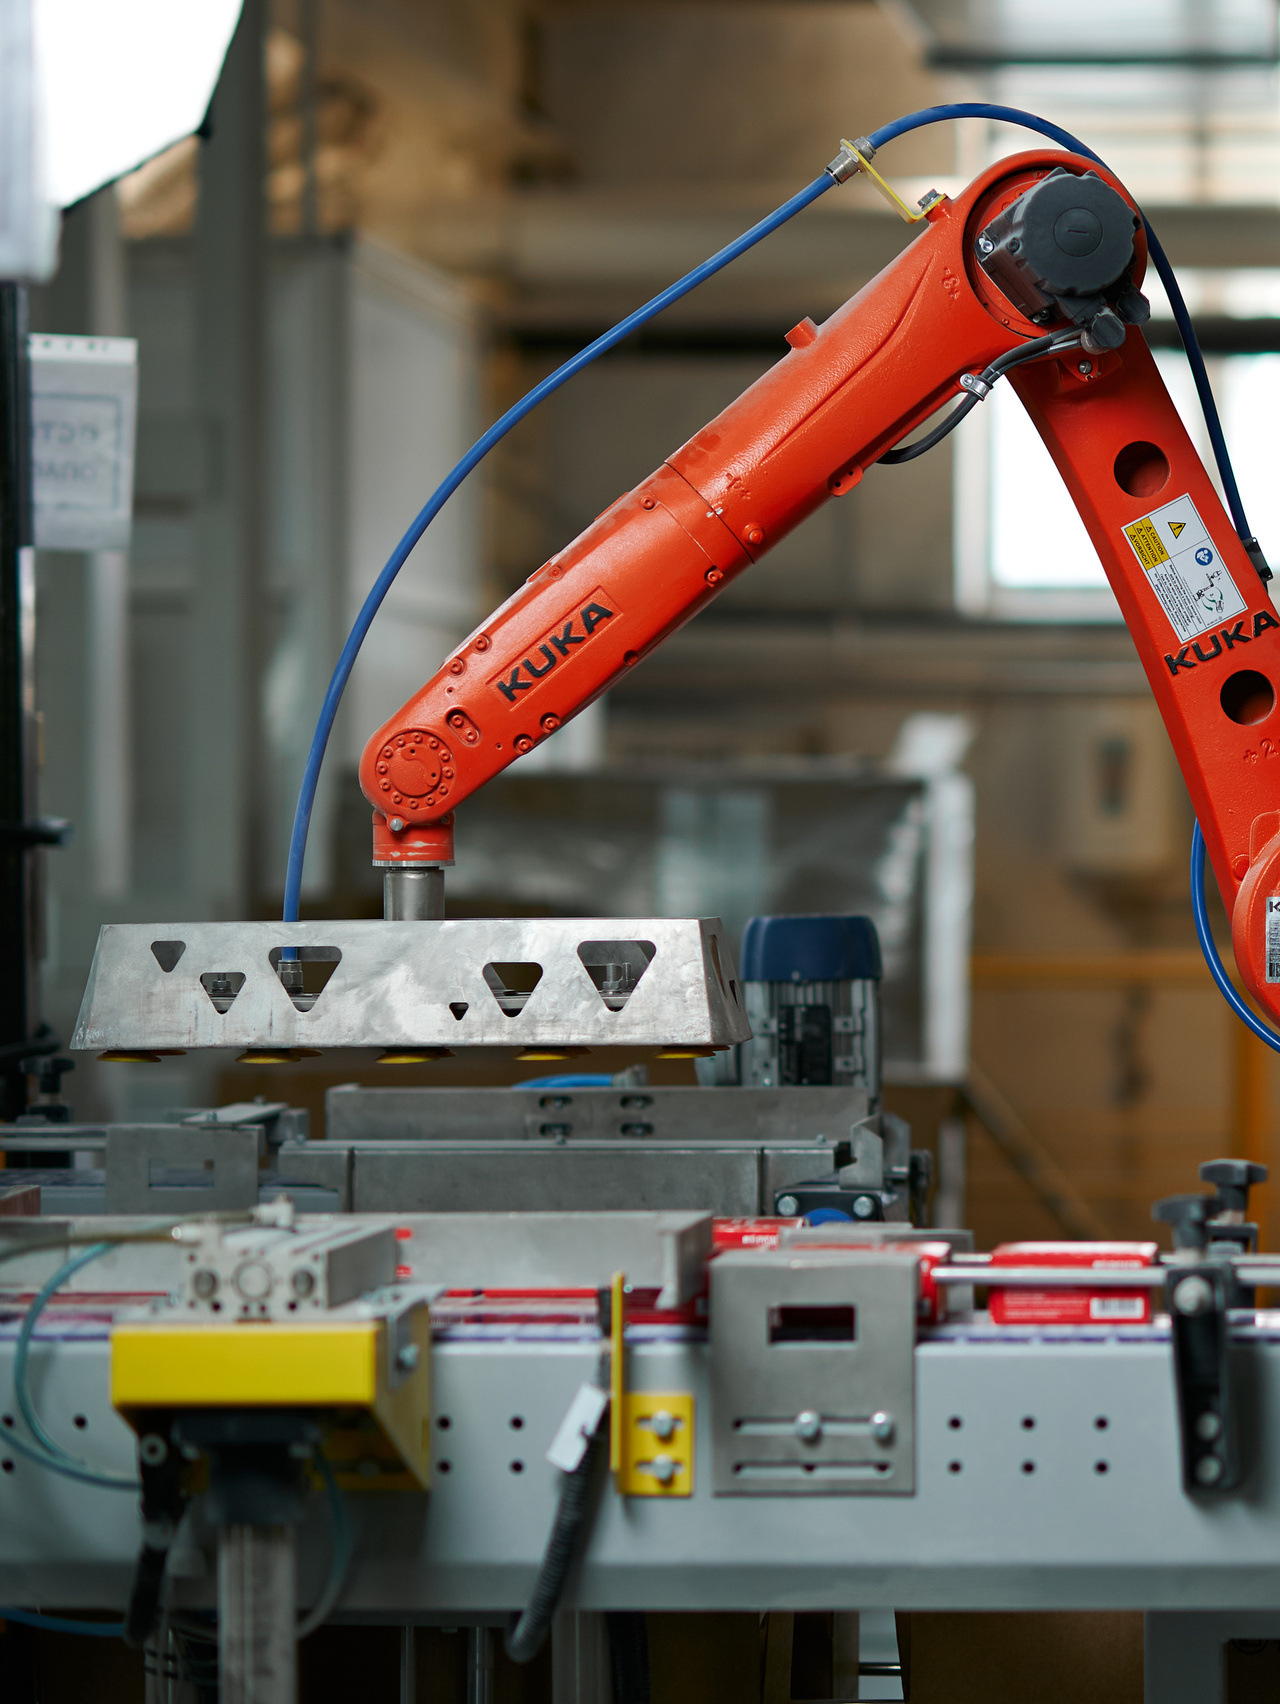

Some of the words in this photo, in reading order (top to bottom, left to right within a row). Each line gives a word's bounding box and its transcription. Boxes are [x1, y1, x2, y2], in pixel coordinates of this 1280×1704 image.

[1132, 537, 1150, 566] VORSICHT
[1139, 532, 1158, 562] ATTENTION
[1148, 531, 1165, 556] CAUTION
[497, 602, 614, 702] KUKA
[1164, 610, 1280, 676] KUKA
